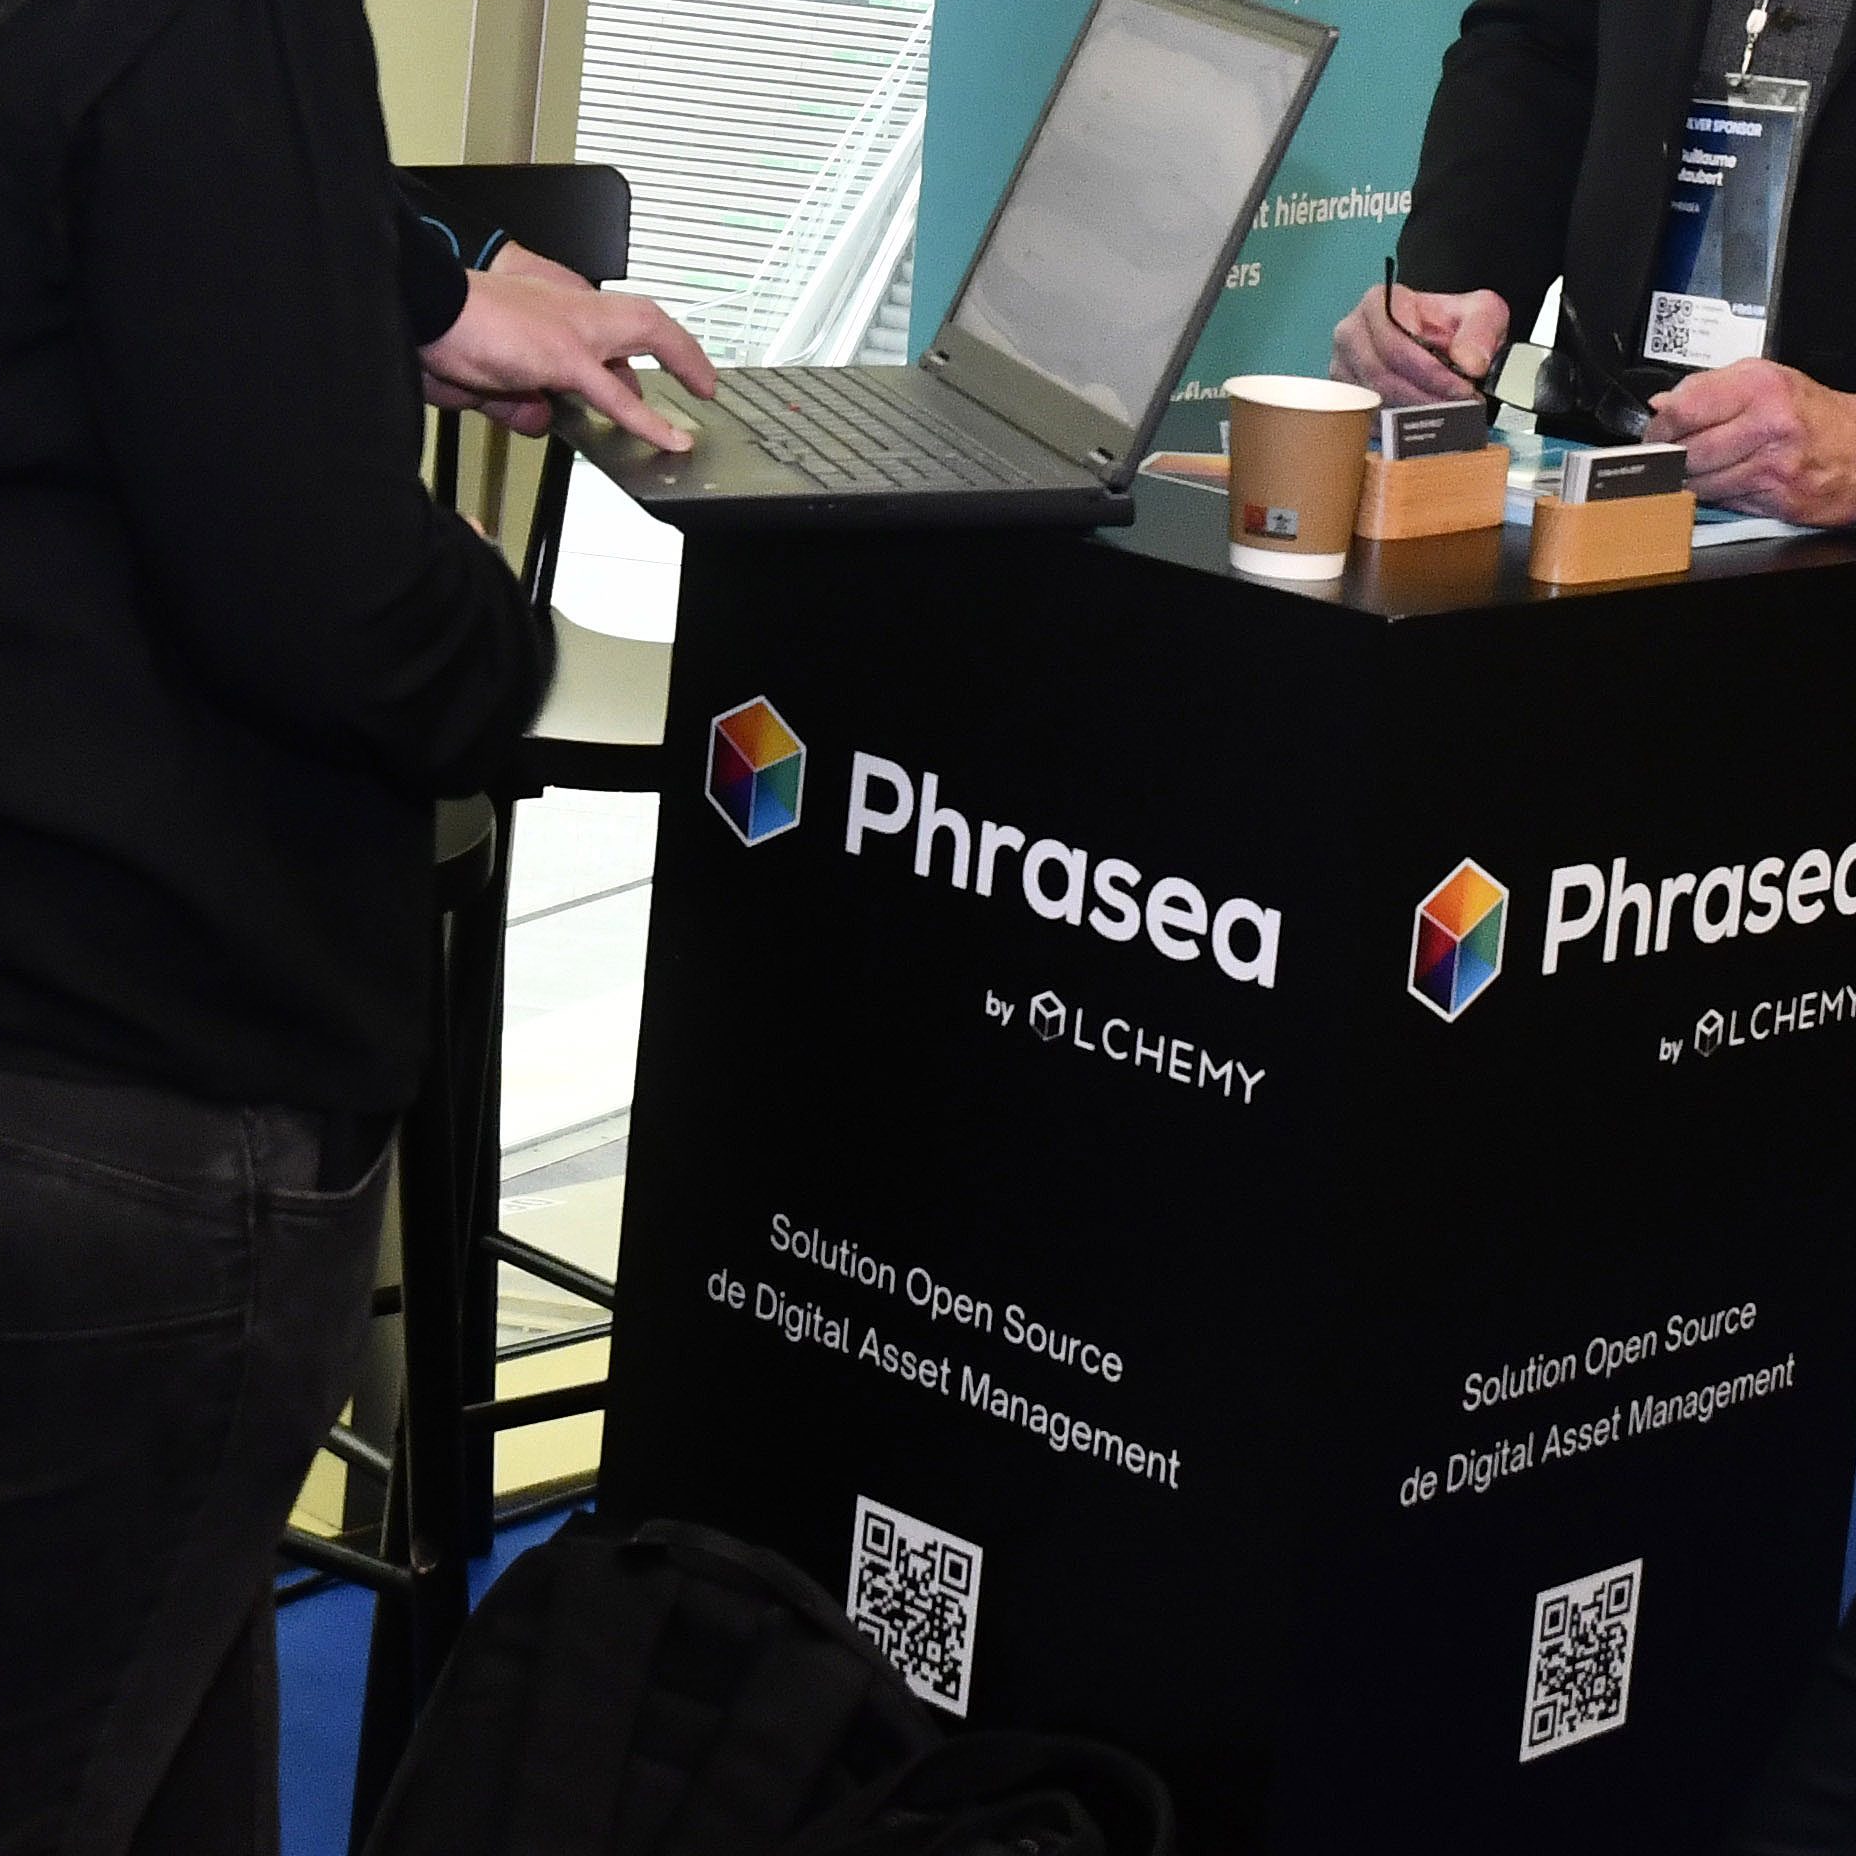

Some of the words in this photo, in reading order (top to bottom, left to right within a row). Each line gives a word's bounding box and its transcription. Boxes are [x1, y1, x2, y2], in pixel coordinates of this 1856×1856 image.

[1275, 184, 1411, 226] hiérarchique
[846, 752, 1281, 988] Phrasea
[986, 990, 1014, 1026] by
[1659, 1038, 1683, 1063] by
[771, 1214, 895, 1294] Solution
[906, 1267, 992, 1332] Open
[1003, 1305, 1123, 1382] Source
[1463, 1354, 1576, 1411] Solution
[1585, 1331, 1657, 1378] Open
[1665, 1303, 1756, 1351] Source
[708, 1269, 746, 1309] de
[756, 1283, 849, 1353] Digital
[859, 1328, 951, 1395] Asset
[961, 1366, 1180, 1489] Management
[1400, 1467, 1437, 1506] de
[1447, 1432, 1534, 1493] Digital
[1541, 1406, 1621, 1463] Asset
[1628, 1353, 1795, 1435] Management
